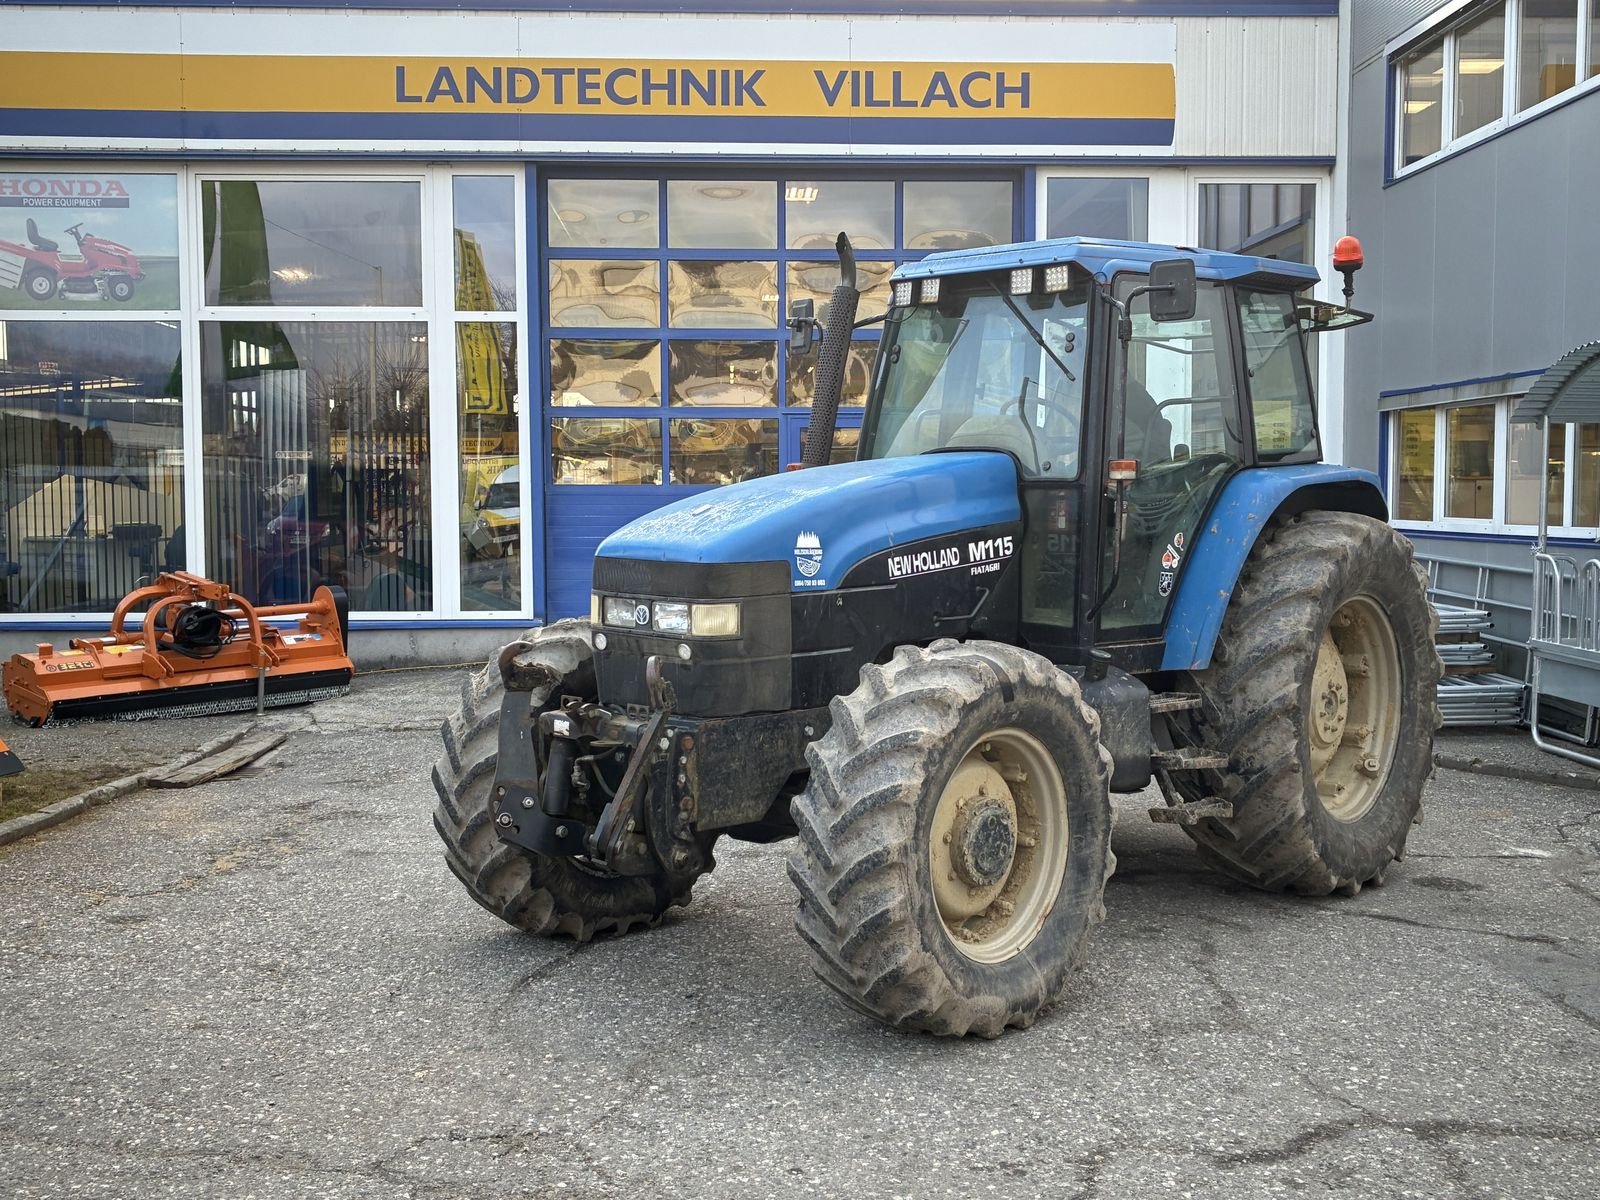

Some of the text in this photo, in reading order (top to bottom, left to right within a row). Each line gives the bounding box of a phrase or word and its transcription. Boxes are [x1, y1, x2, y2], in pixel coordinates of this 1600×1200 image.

[395, 65, 1031, 108] LANDTECHNIK VILLACH
[0, 178, 130, 196] HONDA
[22, 198, 102, 207] POWER EQUIPMENT
[887, 536, 1013, 578] NEW HOLLAND M115
[970, 562, 1000, 576] FIATAGRI
